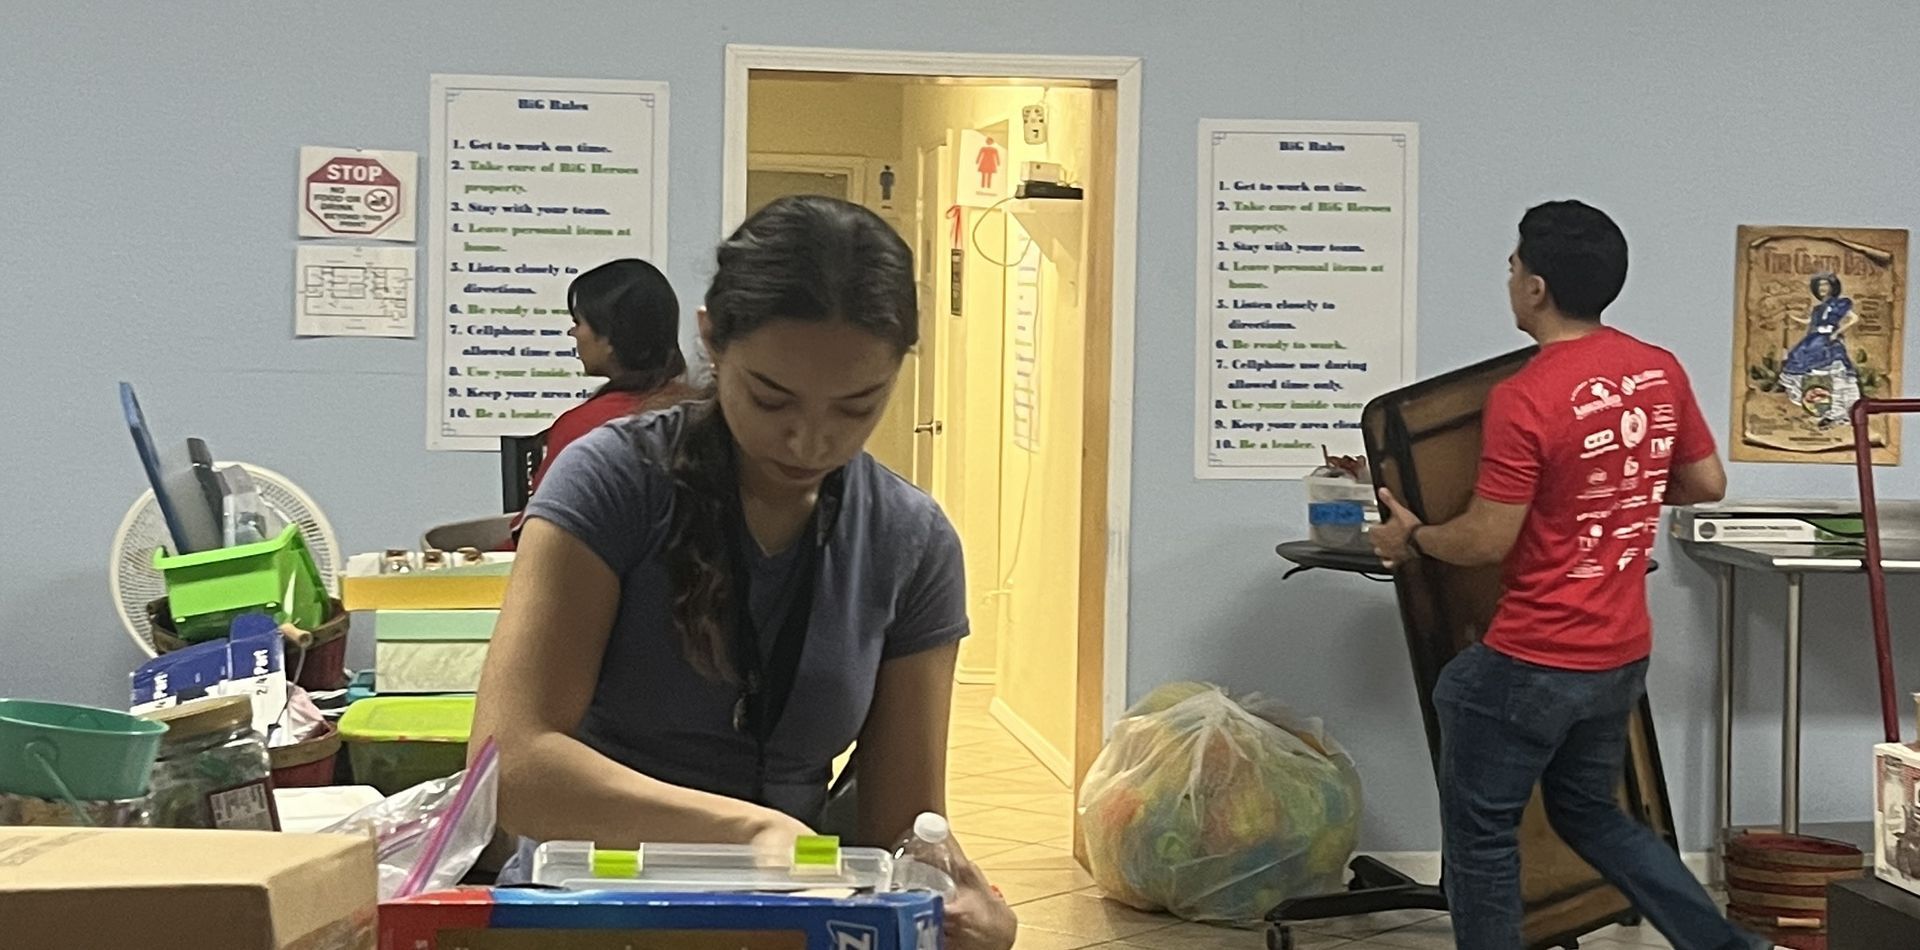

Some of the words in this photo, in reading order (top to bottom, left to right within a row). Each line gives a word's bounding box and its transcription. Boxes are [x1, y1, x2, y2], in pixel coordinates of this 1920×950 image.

[550, 99, 589, 111] Rules
[453, 139, 464, 150] 1.
[469, 140, 492, 150] Get
[497, 142, 511, 150] to
[516, 142, 551, 151] work
[555, 144, 573, 152] on
[1309, 142, 1345, 152] Rules
[327, 164, 383, 182] STOP
[451, 161, 464, 170] 2.
[469, 161, 504, 172] Take
[508, 164, 536, 173] care
[541, 162, 555, 173] of
[592, 163, 639, 174] Heroes
[1219, 181, 1230, 191] 1.
[1234, 181, 1256, 191] Get
[1260, 182, 1273, 191] to
[1277, 182, 1310, 192] work
[1314, 184, 1330, 192] on
[314, 194, 344, 203] FOOD
[468, 202, 498, 215] Stay
[502, 204, 533, 214] with
[538, 207, 569, 216] your
[1217, 202, 1229, 211] 2.
[1234, 202, 1267, 211] Take
[1268, 203, 1296, 211] care
[1300, 202, 1313, 212] of
[1347, 203, 1392, 213] Heroes
[469, 224, 509, 234] Leave
[512, 225, 572, 237] personal
[576, 226, 613, 236] items
[617, 228, 631, 236] at
[1233, 242, 1260, 254] Stay
[1264, 242, 1293, 252] with
[1297, 245, 1326, 254] your
[450, 263, 463, 273] 5.
[468, 263, 511, 273] Listen
[515, 263, 560, 277] closely
[565, 265, 578, 274] to
[1233, 262, 1270, 272] Leave
[1273, 263, 1329, 274] personal
[1333, 263, 1367, 272] items
[1370, 264, 1384, 272] at
[449, 304, 463, 314] 6.
[467, 304, 486, 315] Be
[490, 305, 529, 317] ready
[533, 306, 547, 315] to
[1216, 300, 1229, 309] 5.
[1233, 300, 1273, 310] Listen
[1276, 300, 1319, 312] closely
[1322, 302, 1336, 310] to
[449, 325, 463, 335] 7.
[467, 325, 537, 338] Cellphone
[540, 328, 563, 336] use
[462, 346, 516, 356] allowed
[521, 347, 550, 357] time
[1216, 340, 1228, 349] 6.
[1233, 340, 1250, 349] Be
[1253, 340, 1289, 352] ready
[1216, 359, 1228, 369] 7.
[1232, 360, 1295, 372] Cellphone
[1325, 360, 1367, 372] during
[467, 367, 491, 377] Use
[495, 370, 527, 379] your
[531, 368, 573, 378] inside
[1228, 380, 1277, 389] allowed
[1281, 380, 1310, 390] time
[467, 388, 502, 401] Keep
[505, 391, 537, 400] your
[541, 390, 572, 399] area
[1232, 400, 1254, 409] Use
[1258, 402, 1286, 411] your
[1291, 401, 1329, 410] inside
[449, 408, 470, 419] 10.
[475, 409, 494, 419] Be
[1232, 420, 1264, 432] Keep
[1268, 423, 1296, 431] your
[1301, 422, 1329, 430] area
[1216, 440, 1236, 449] 10.
[1240, 440, 1256, 449] Be
